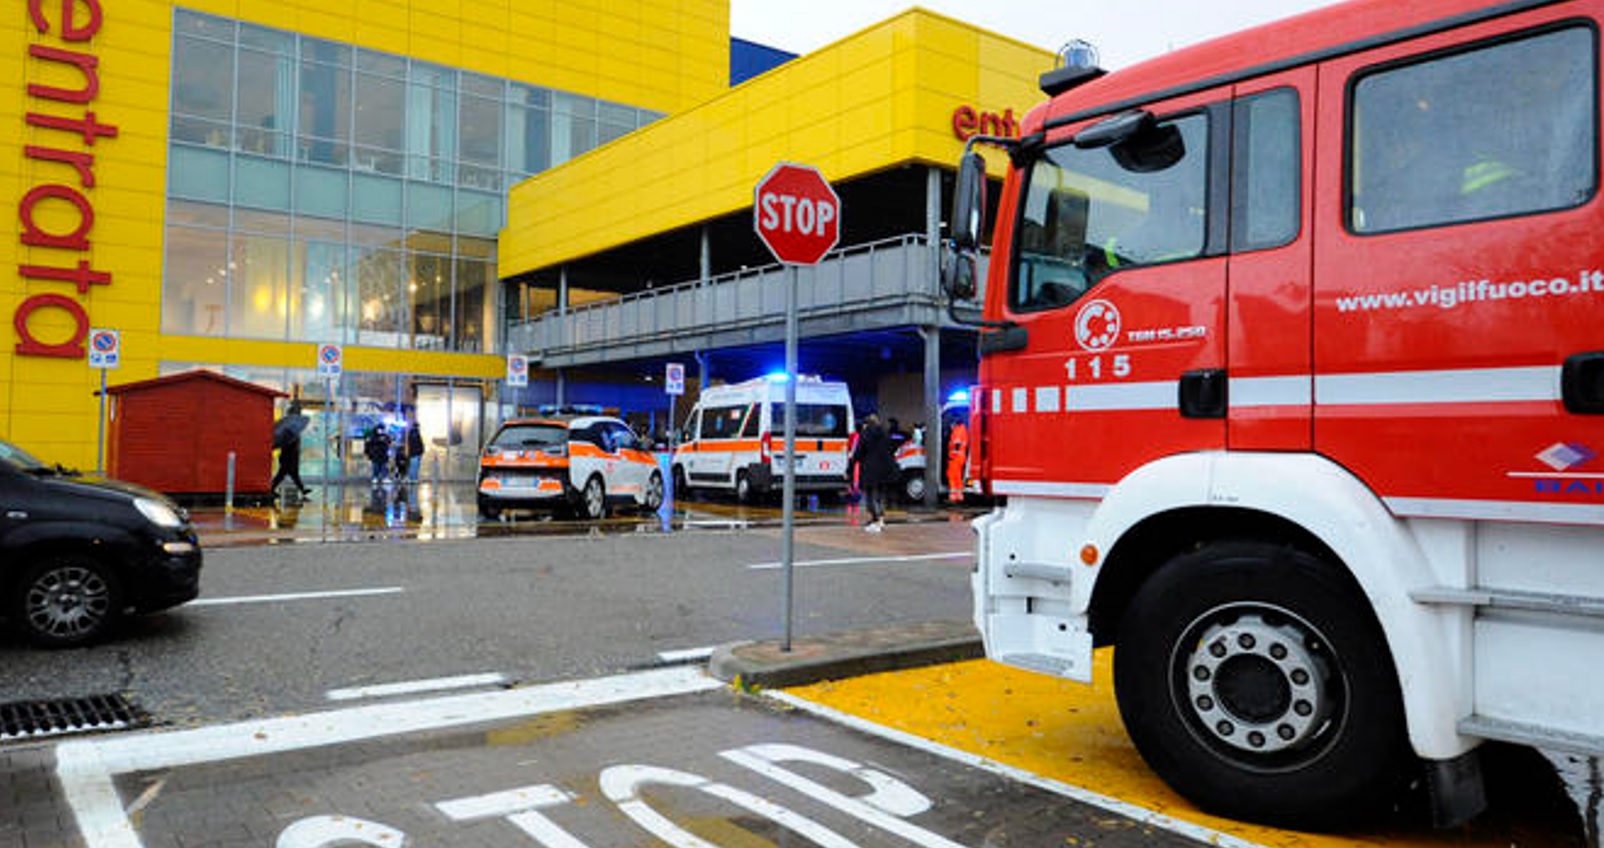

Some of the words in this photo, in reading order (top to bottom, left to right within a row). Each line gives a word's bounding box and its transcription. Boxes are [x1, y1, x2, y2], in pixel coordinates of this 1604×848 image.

[953, 105, 1020, 145] ent
[14, 0, 119, 360] entrata
[762, 192, 834, 237] STOP
[1336, 271, 1604, 311] www.vigilfuoco.it
